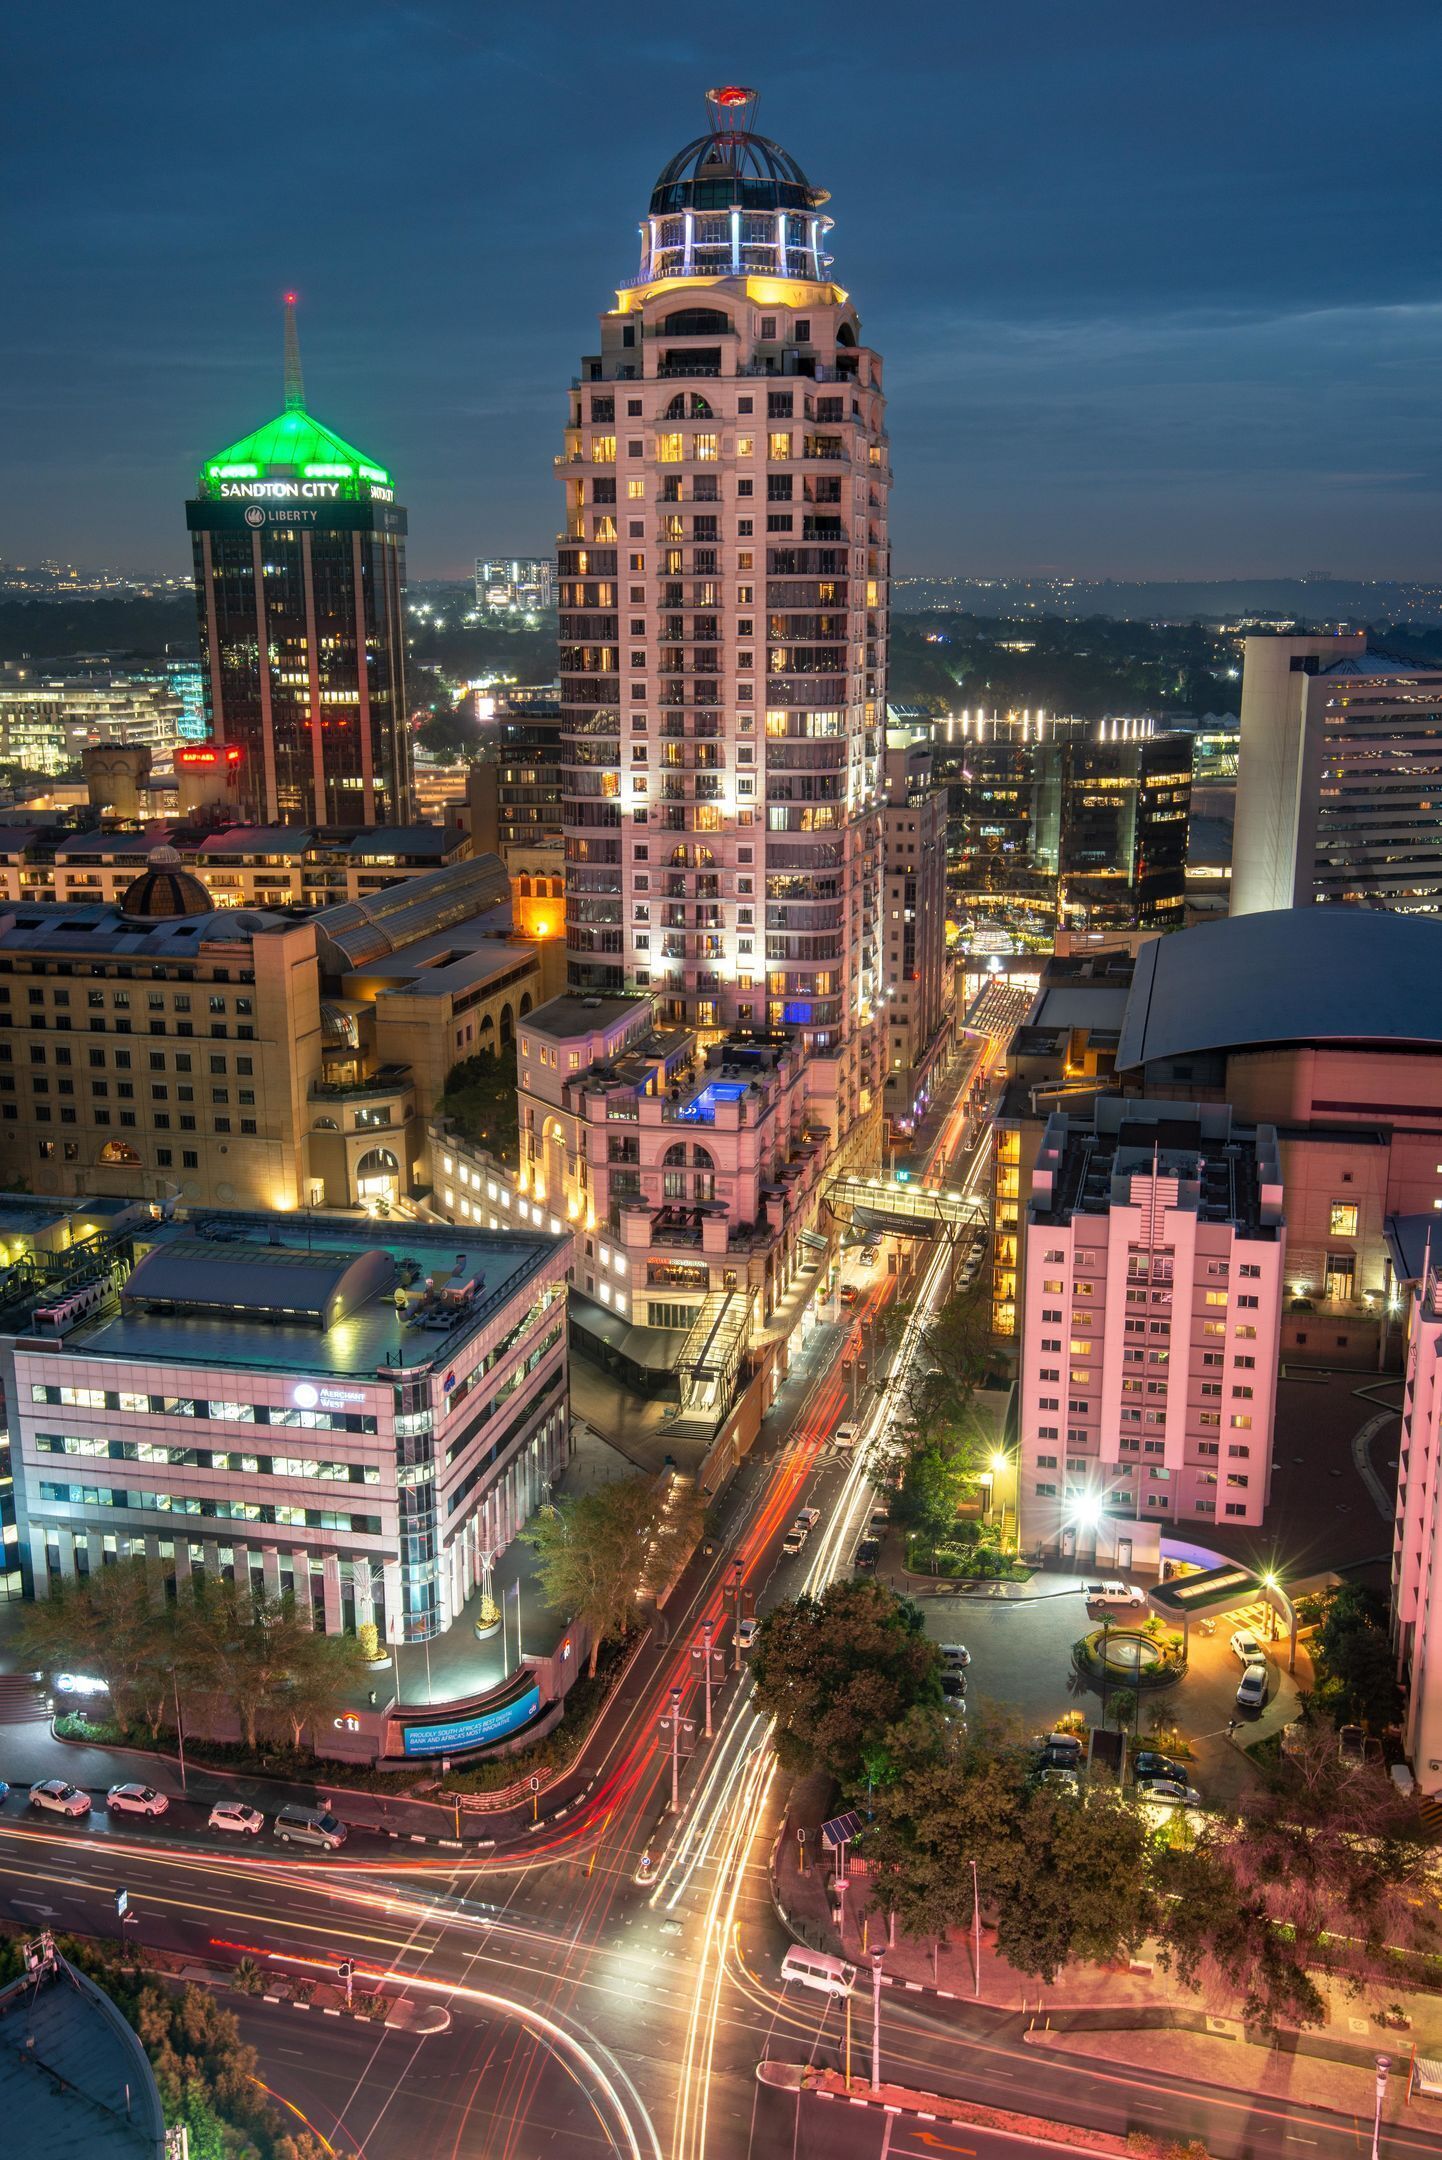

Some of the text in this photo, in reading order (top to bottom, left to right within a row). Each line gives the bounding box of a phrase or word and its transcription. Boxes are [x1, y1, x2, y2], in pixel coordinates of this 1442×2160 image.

[221, 483, 340, 497] SANDTON CITY
[268, 510, 318, 521] LIBERTY
[320, 1399, 345, 1408] WEST
[410, 1730, 437, 1739] PROUDLY
[438, 1728, 458, 1737] SOUTH
[466, 1728, 481, 1737] MOST
